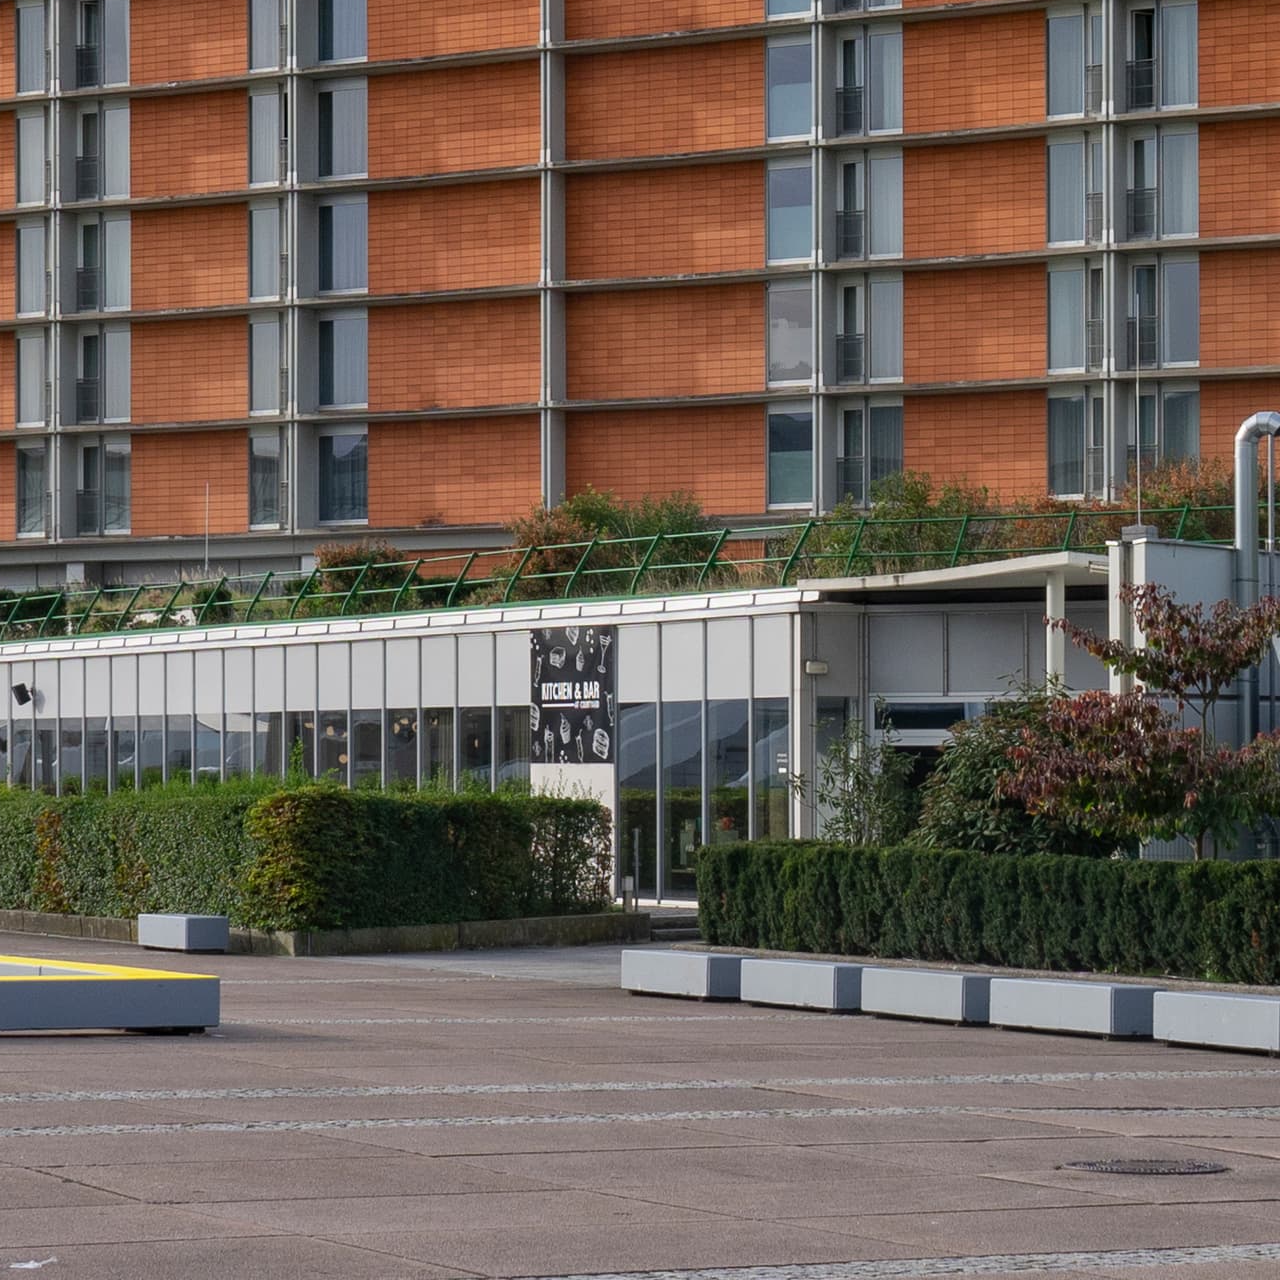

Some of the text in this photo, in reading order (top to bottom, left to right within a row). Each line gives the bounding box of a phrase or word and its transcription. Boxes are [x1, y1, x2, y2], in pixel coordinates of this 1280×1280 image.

[541, 681, 600, 701] KITCHEN & BAR
